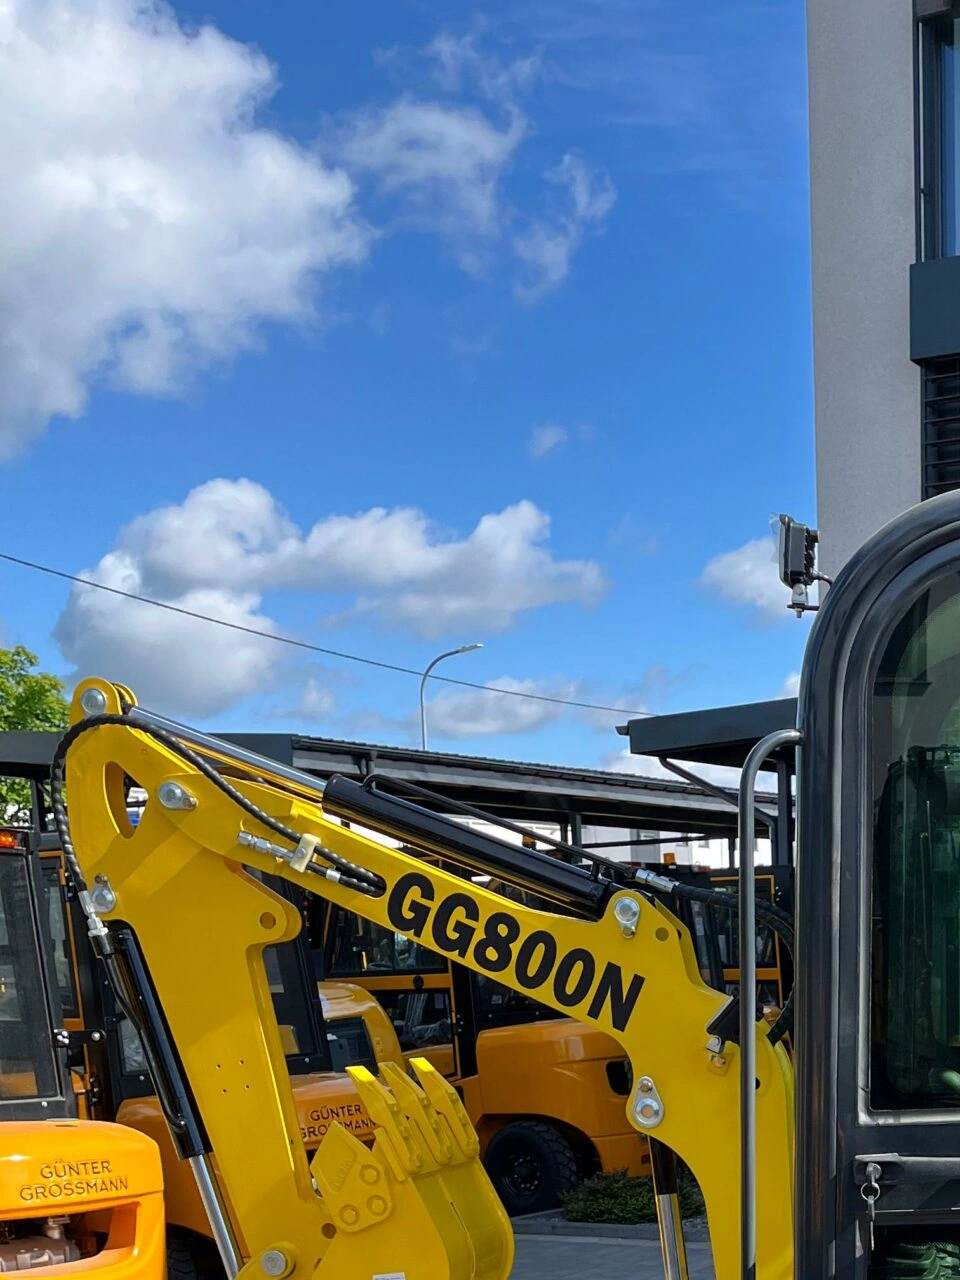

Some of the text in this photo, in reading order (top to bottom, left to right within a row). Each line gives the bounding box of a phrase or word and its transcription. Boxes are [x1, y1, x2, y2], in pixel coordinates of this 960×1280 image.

[387, 872, 646, 1032] GG800N
[310, 1104, 362, 1121] GÜNTER
[300, 1118, 376, 1138] GROMANN
[40, 1159, 112, 1179] GÜNTER
[20, 1178, 128, 1201] GROSSMANN
